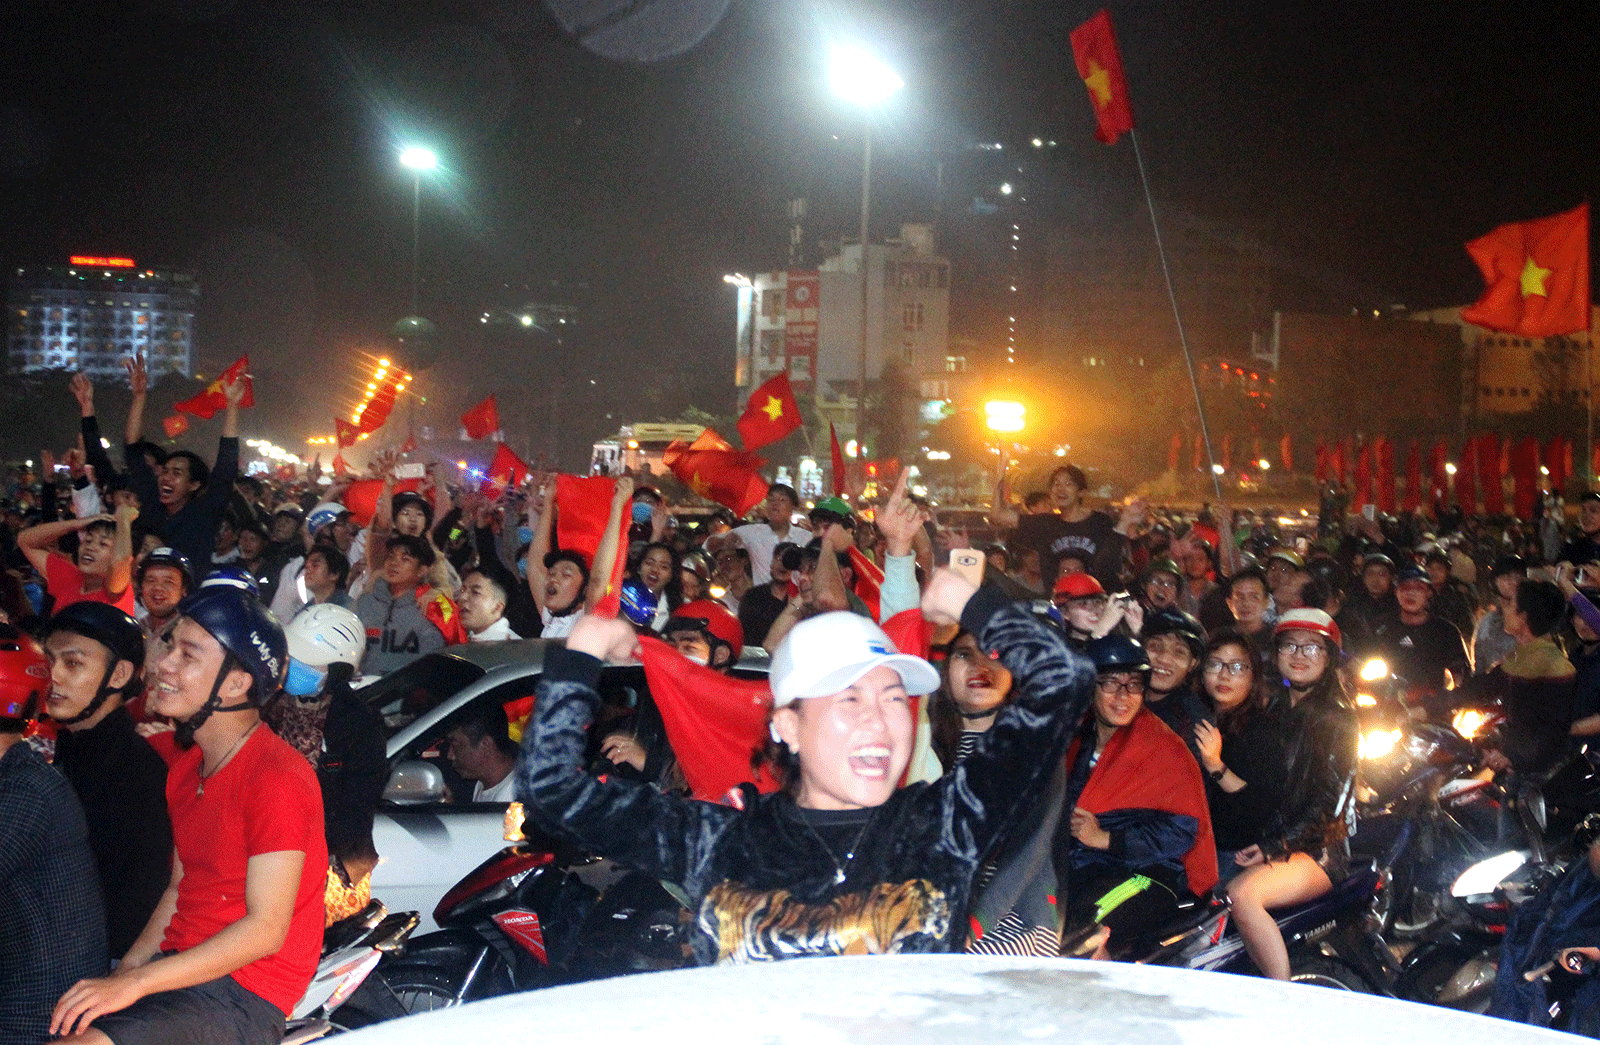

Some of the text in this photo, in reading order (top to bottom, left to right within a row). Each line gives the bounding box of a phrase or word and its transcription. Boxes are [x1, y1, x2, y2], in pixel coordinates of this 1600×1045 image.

[365, 628, 420, 654] FILA
[504, 915, 534, 924] HONDA
[1304, 919, 1337, 940] YAMAHA
